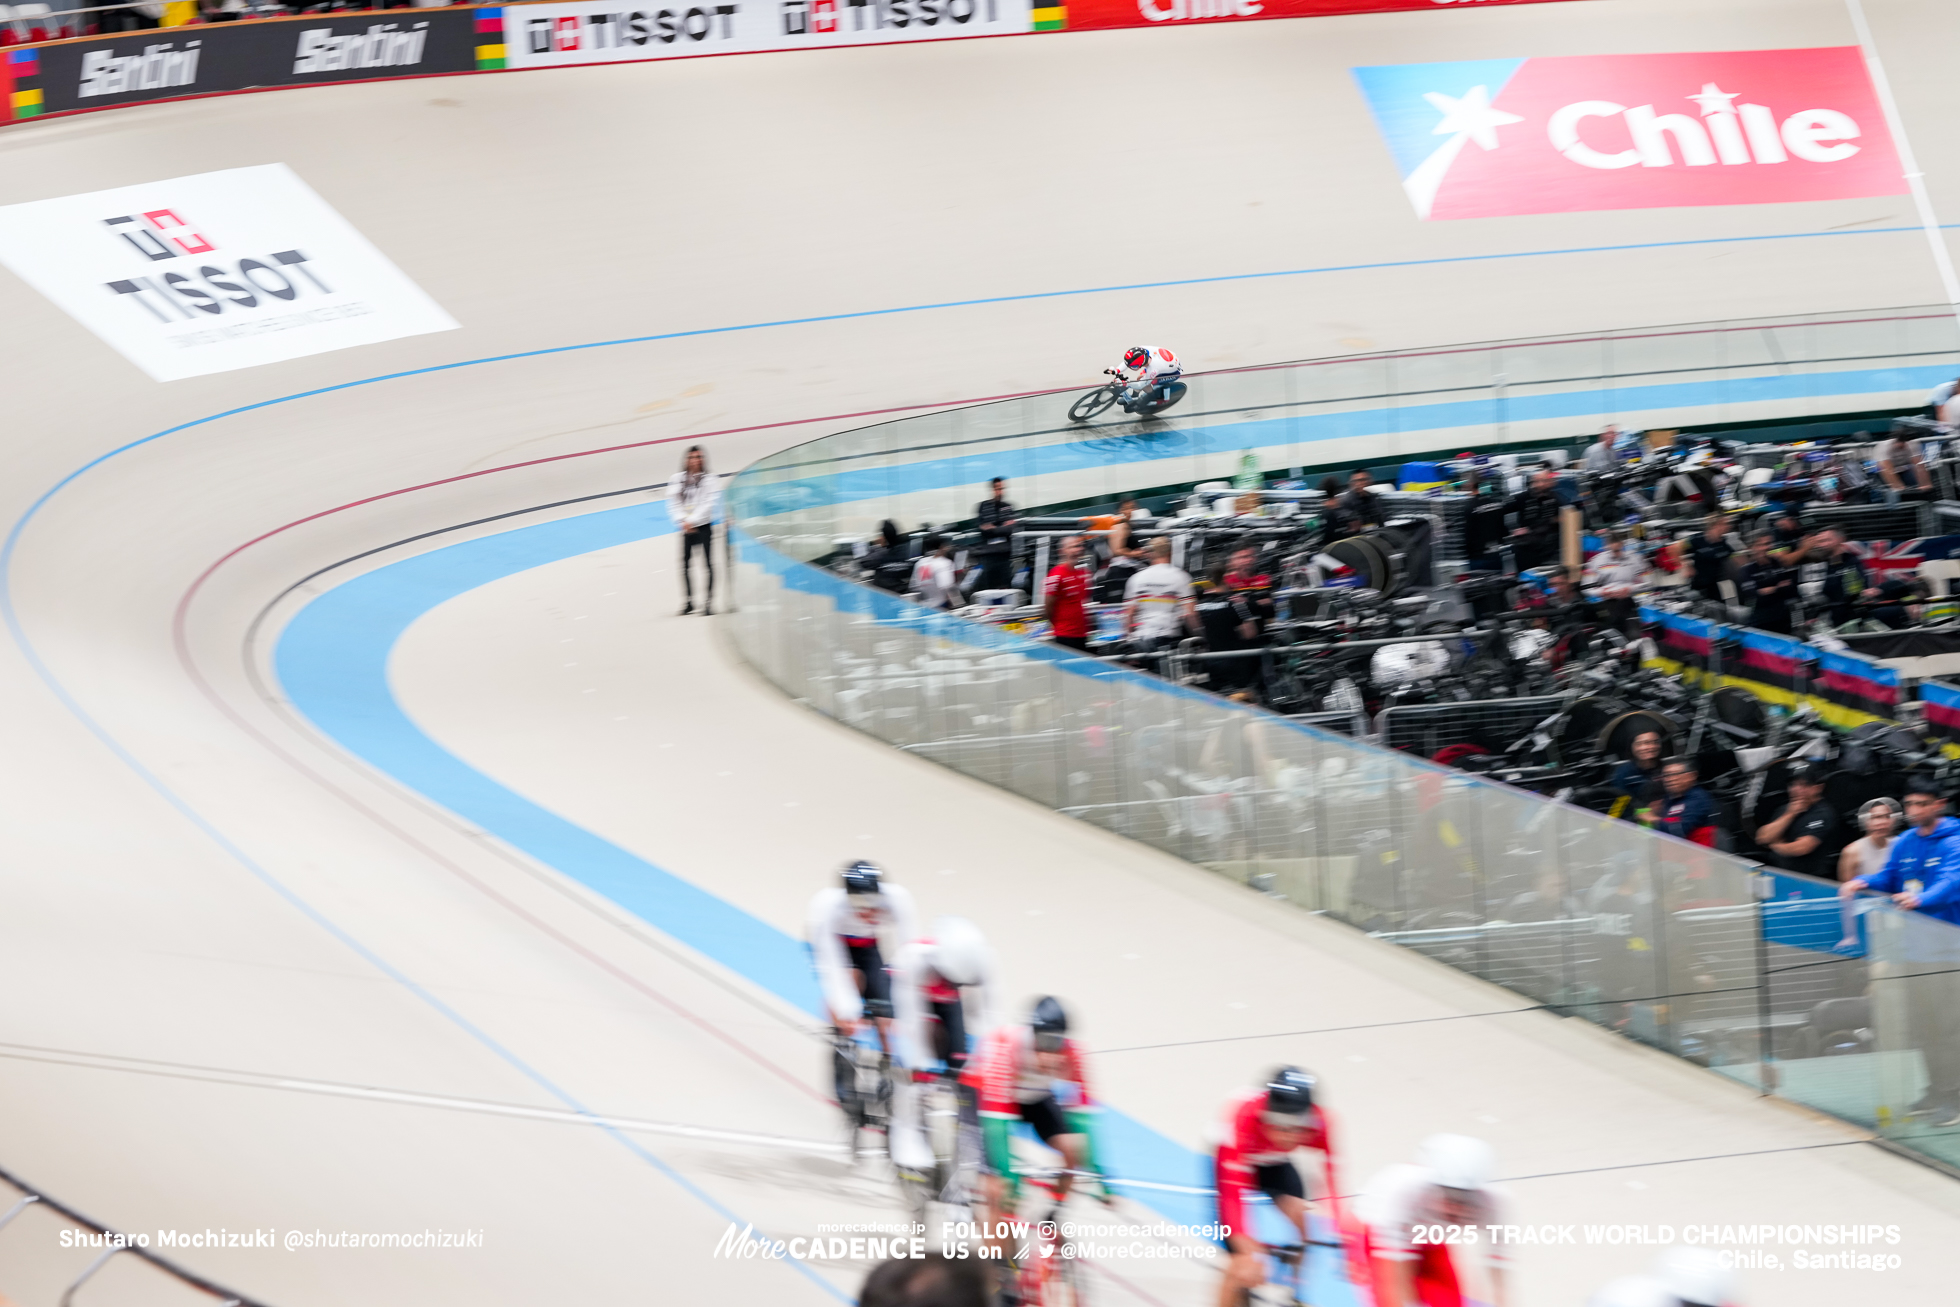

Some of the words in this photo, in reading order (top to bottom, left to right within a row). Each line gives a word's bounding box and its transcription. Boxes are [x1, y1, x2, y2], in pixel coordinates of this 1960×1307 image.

[292, 21, 430, 75] Santini
[586, 4, 742, 49] TISSOT
[78, 39, 201, 99] Santini
[1547, 83, 1862, 170] Chile
[103, 248, 335, 324] TISSOT
